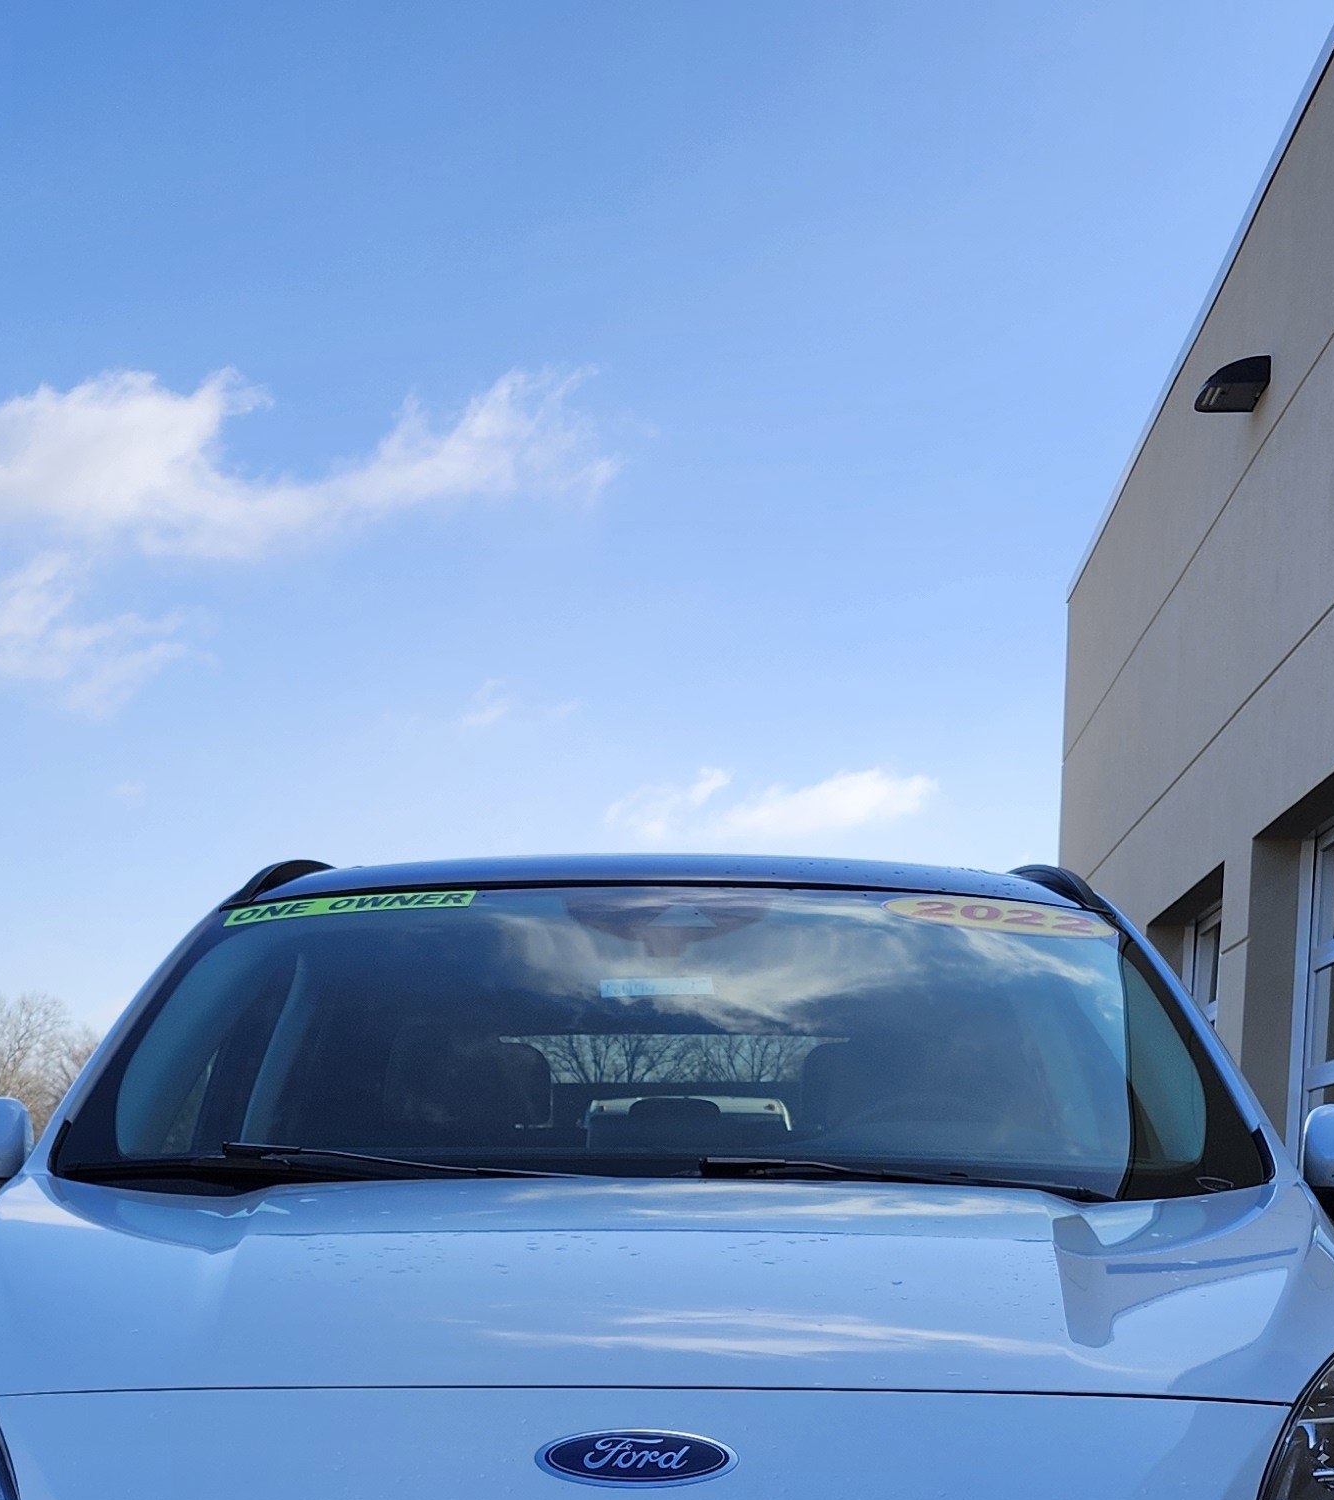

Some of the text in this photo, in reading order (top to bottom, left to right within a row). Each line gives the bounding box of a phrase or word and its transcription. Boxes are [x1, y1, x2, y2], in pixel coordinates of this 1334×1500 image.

[233, 892, 470, 923] ONE OWNER
[911, 900, 1094, 935] 2022
[583, 1436, 690, 1470] Ford
